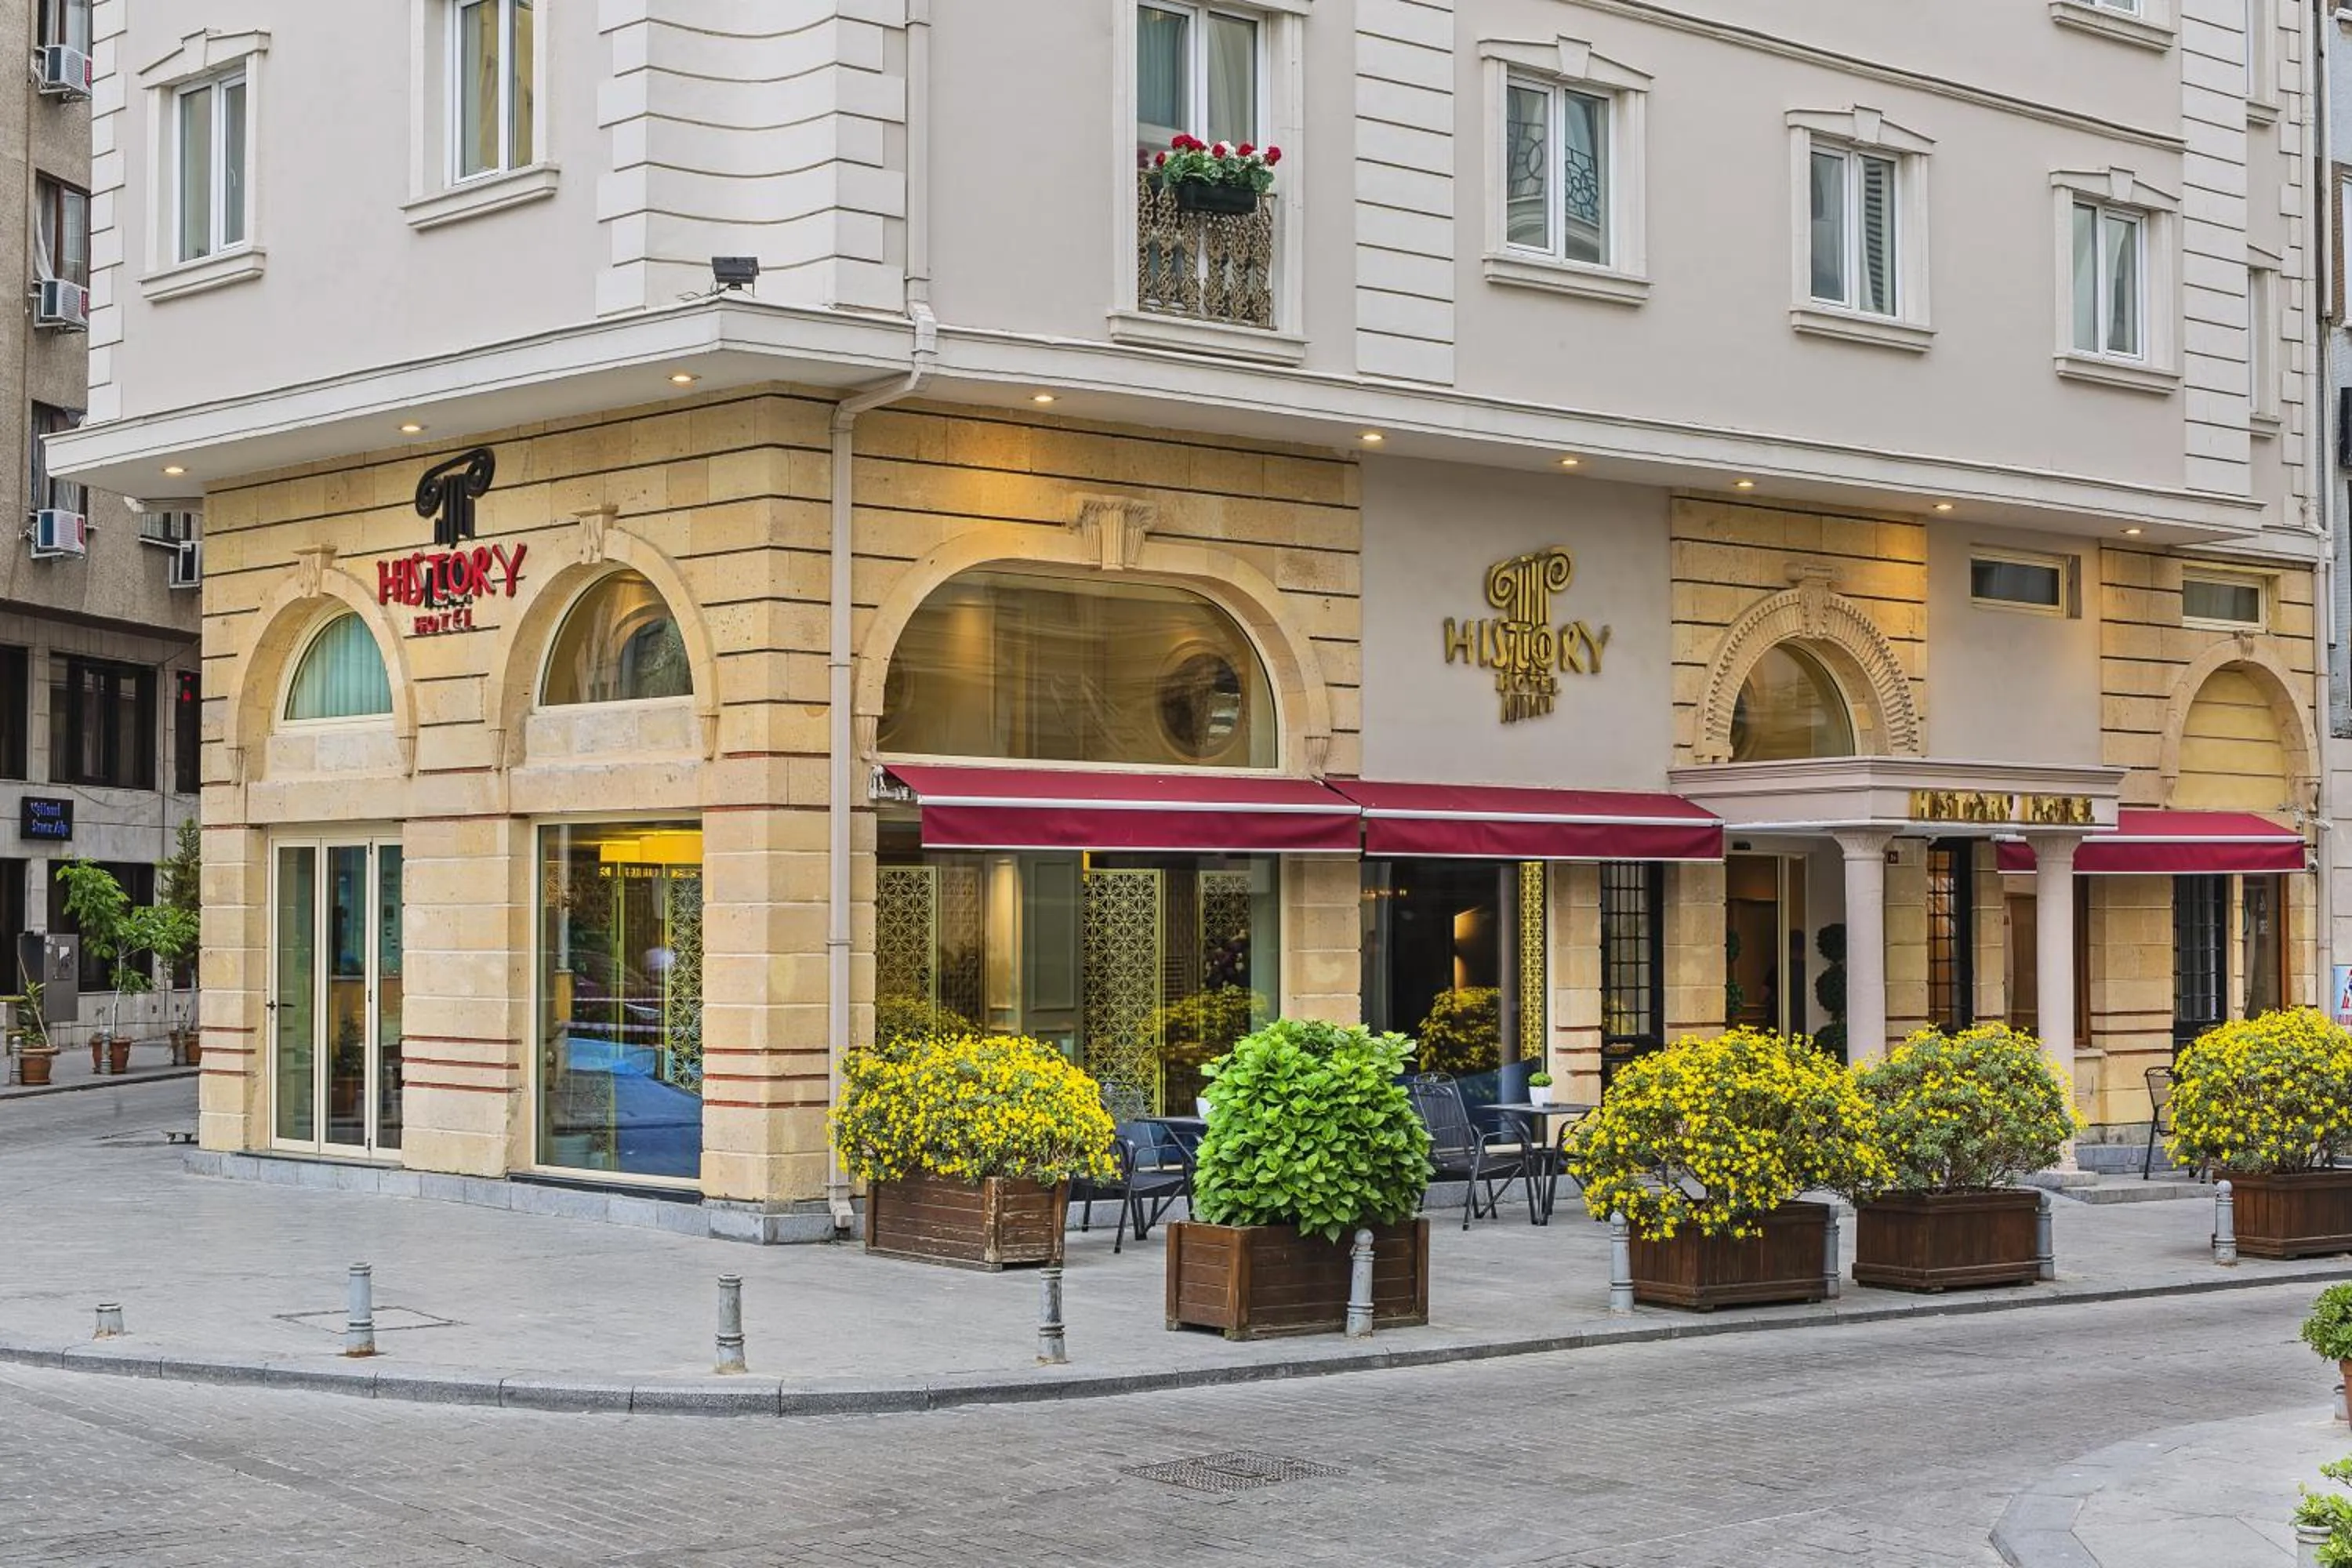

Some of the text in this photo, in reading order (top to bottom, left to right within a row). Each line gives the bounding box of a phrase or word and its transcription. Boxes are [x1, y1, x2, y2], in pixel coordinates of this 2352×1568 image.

[376, 543, 528, 606] HISTORY
[414, 608, 473, 634] HOTEL
[1443, 616, 1612, 674] HISTORY
[1910, 789, 2095, 823] HISTORY HOTEL
